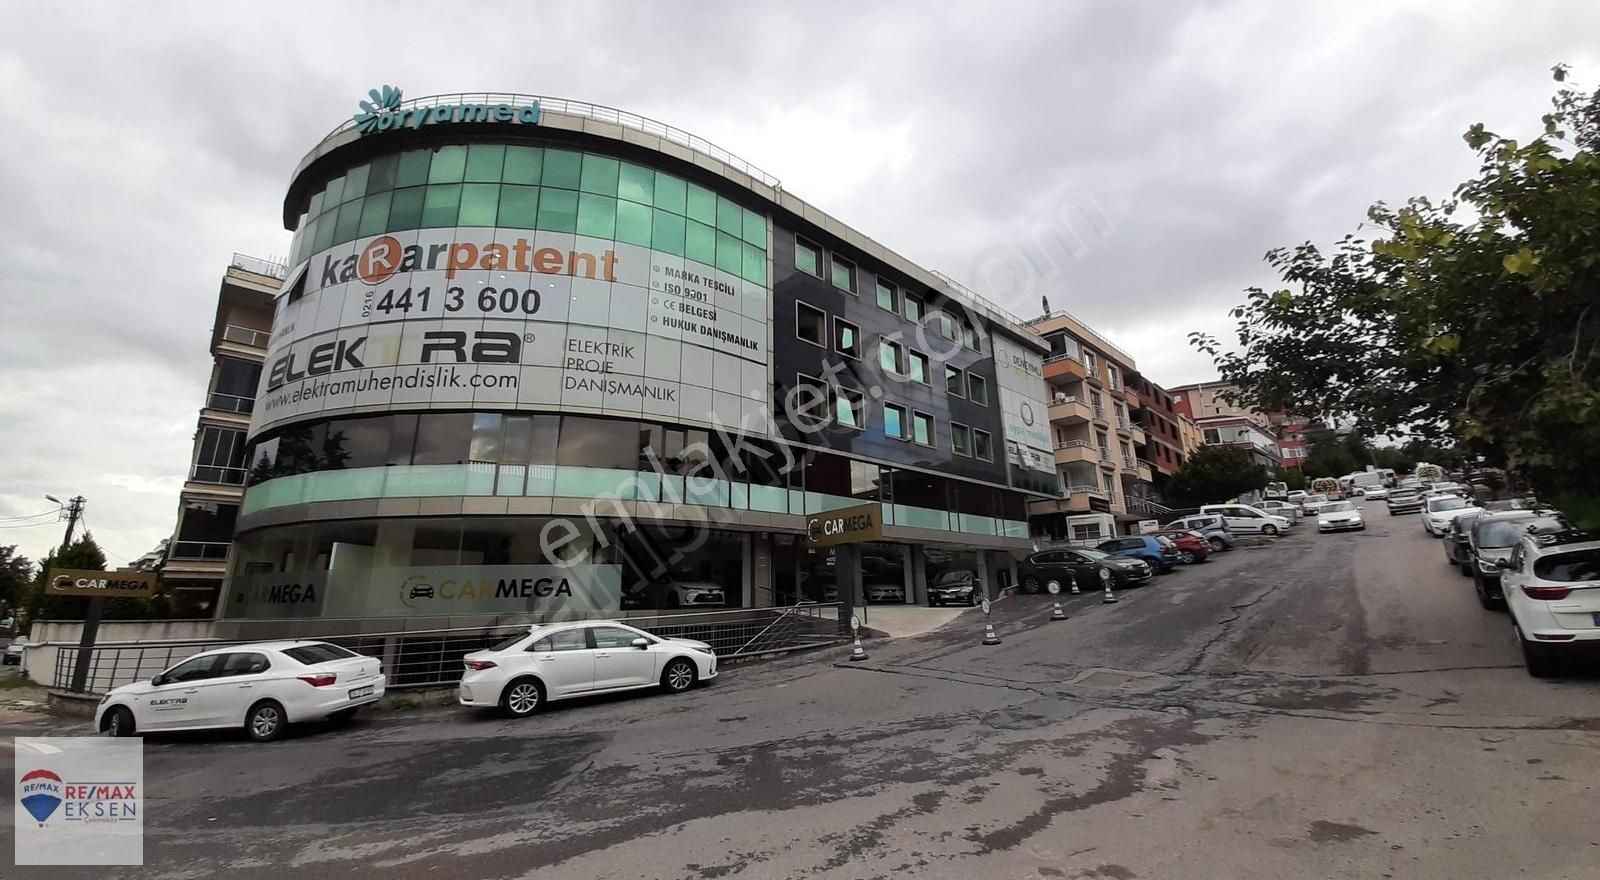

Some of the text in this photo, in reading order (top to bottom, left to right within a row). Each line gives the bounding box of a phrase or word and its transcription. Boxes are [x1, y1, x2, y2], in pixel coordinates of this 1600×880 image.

[378, 100, 541, 131] oryamed
[665, 266, 700, 285] MARKA
[664, 282, 681, 294] ISO
[361, 290, 375, 318] 0216
[376, 286, 541, 315] 441 3 600
[662, 316, 759, 351] HUKUK DANIŞMANLIK
[568, 339, 635, 359] ELEKTRİK
[566, 357, 614, 375] PROJE
[265, 366, 518, 411] www.elektramuhendislik.com
[565, 376, 676, 402] DANIŞMANLIK
[824, 513, 873, 536] CARMEGA
[75, 578, 149, 590] CARMEGA
